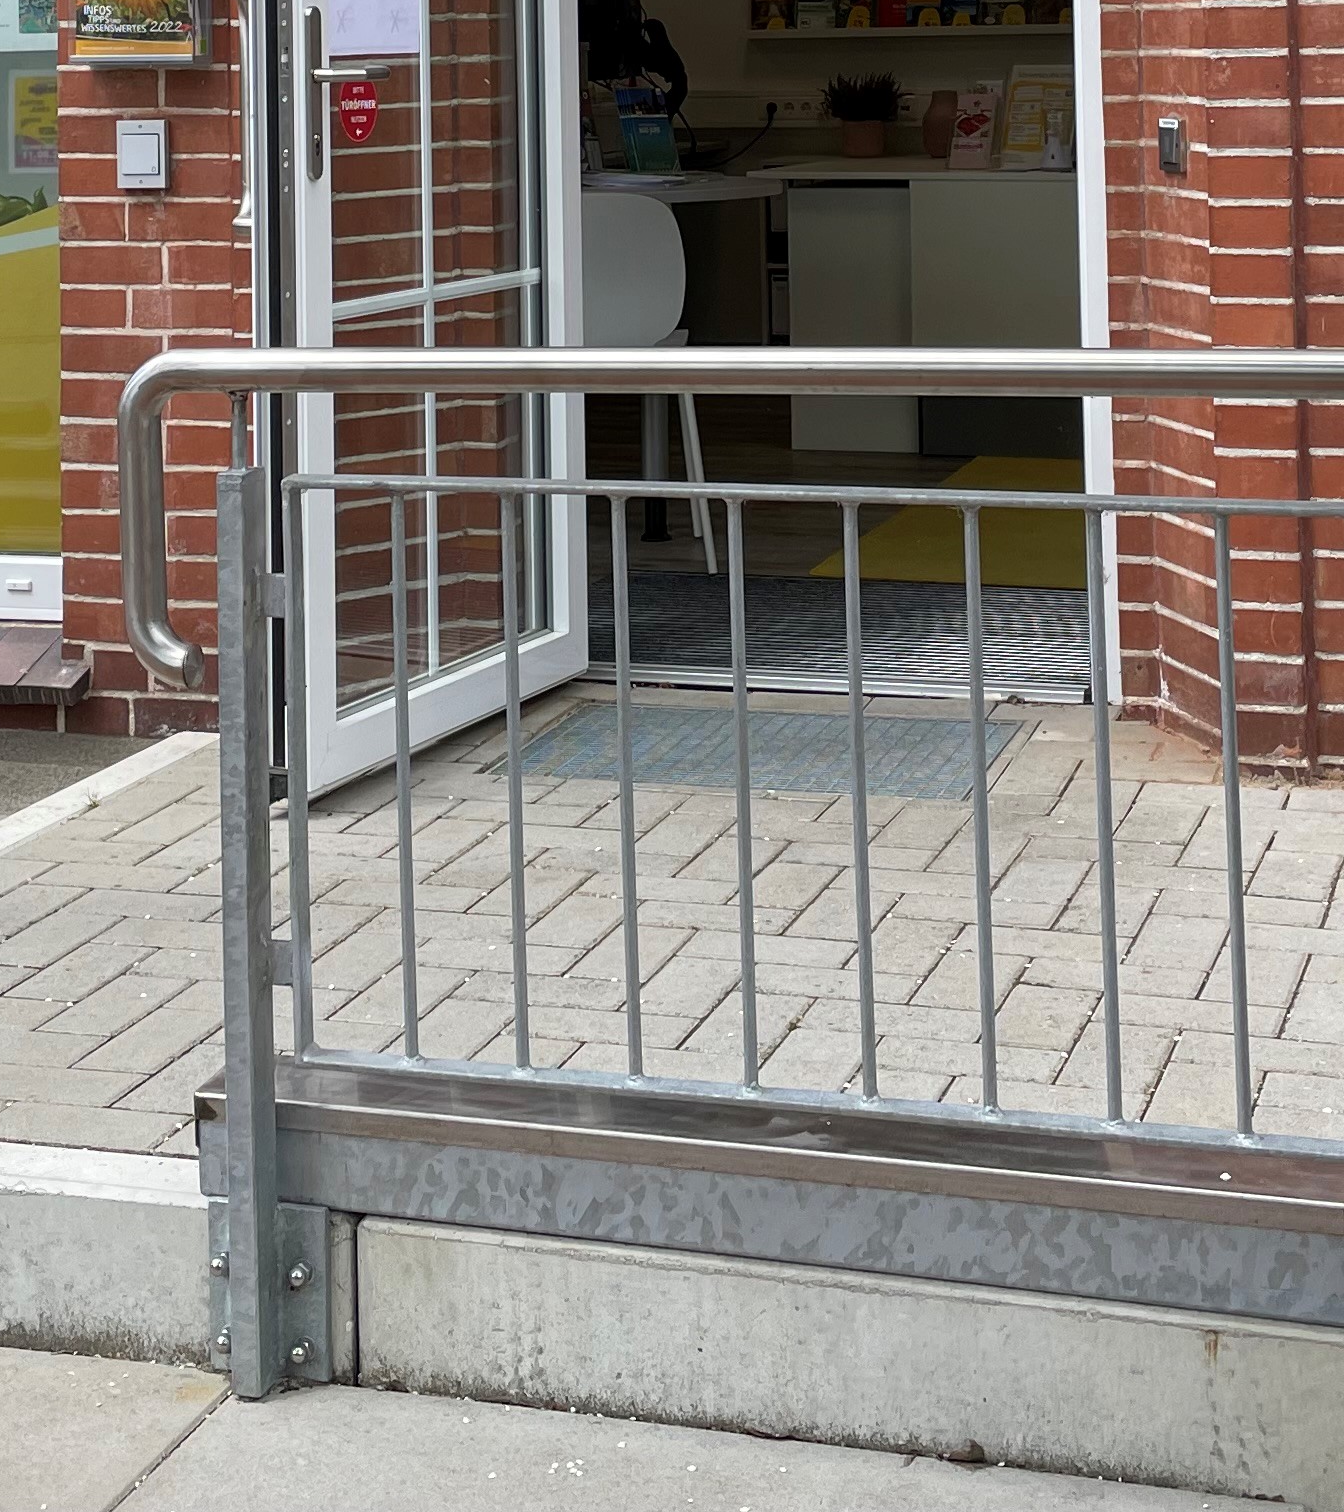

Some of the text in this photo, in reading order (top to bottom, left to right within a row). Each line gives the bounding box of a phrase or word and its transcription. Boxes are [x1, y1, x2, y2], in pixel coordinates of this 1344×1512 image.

[83, 4, 113, 16] INFOS
[88, 15, 110, 24] TIPPS
[81, 21, 183, 33] WISSENSWERTES 2022
[341, 98, 376, 111] TÜRÖFFNER
